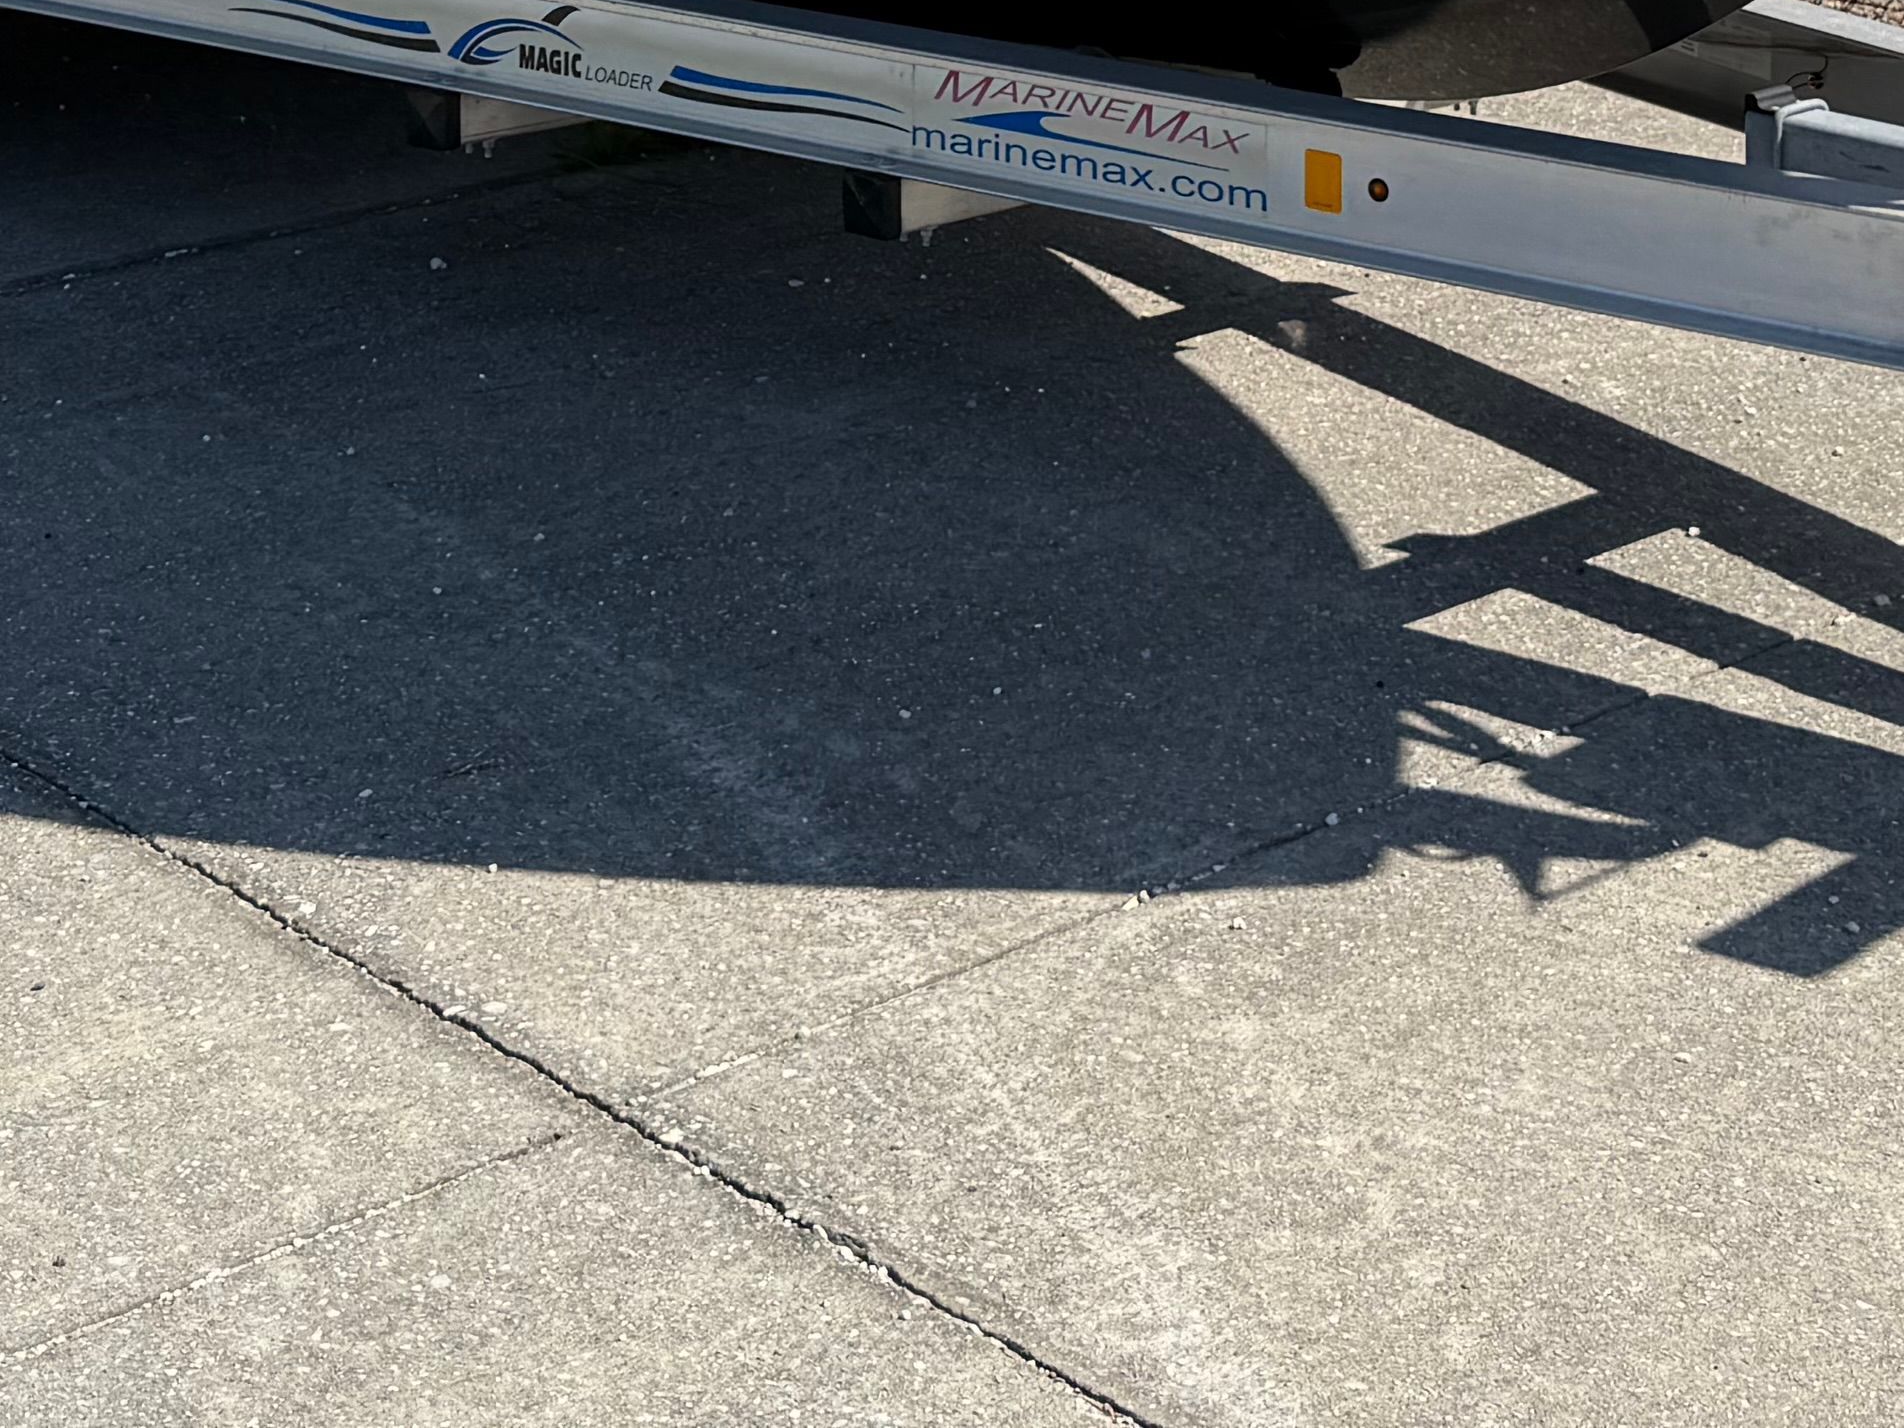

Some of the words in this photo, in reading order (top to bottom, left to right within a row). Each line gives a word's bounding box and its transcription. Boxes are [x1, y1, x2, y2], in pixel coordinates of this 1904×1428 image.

[519, 43, 583, 78] MAGIC
[585, 65, 654, 92] LOADER
[911, 124, 1268, 212] marinemax.com
